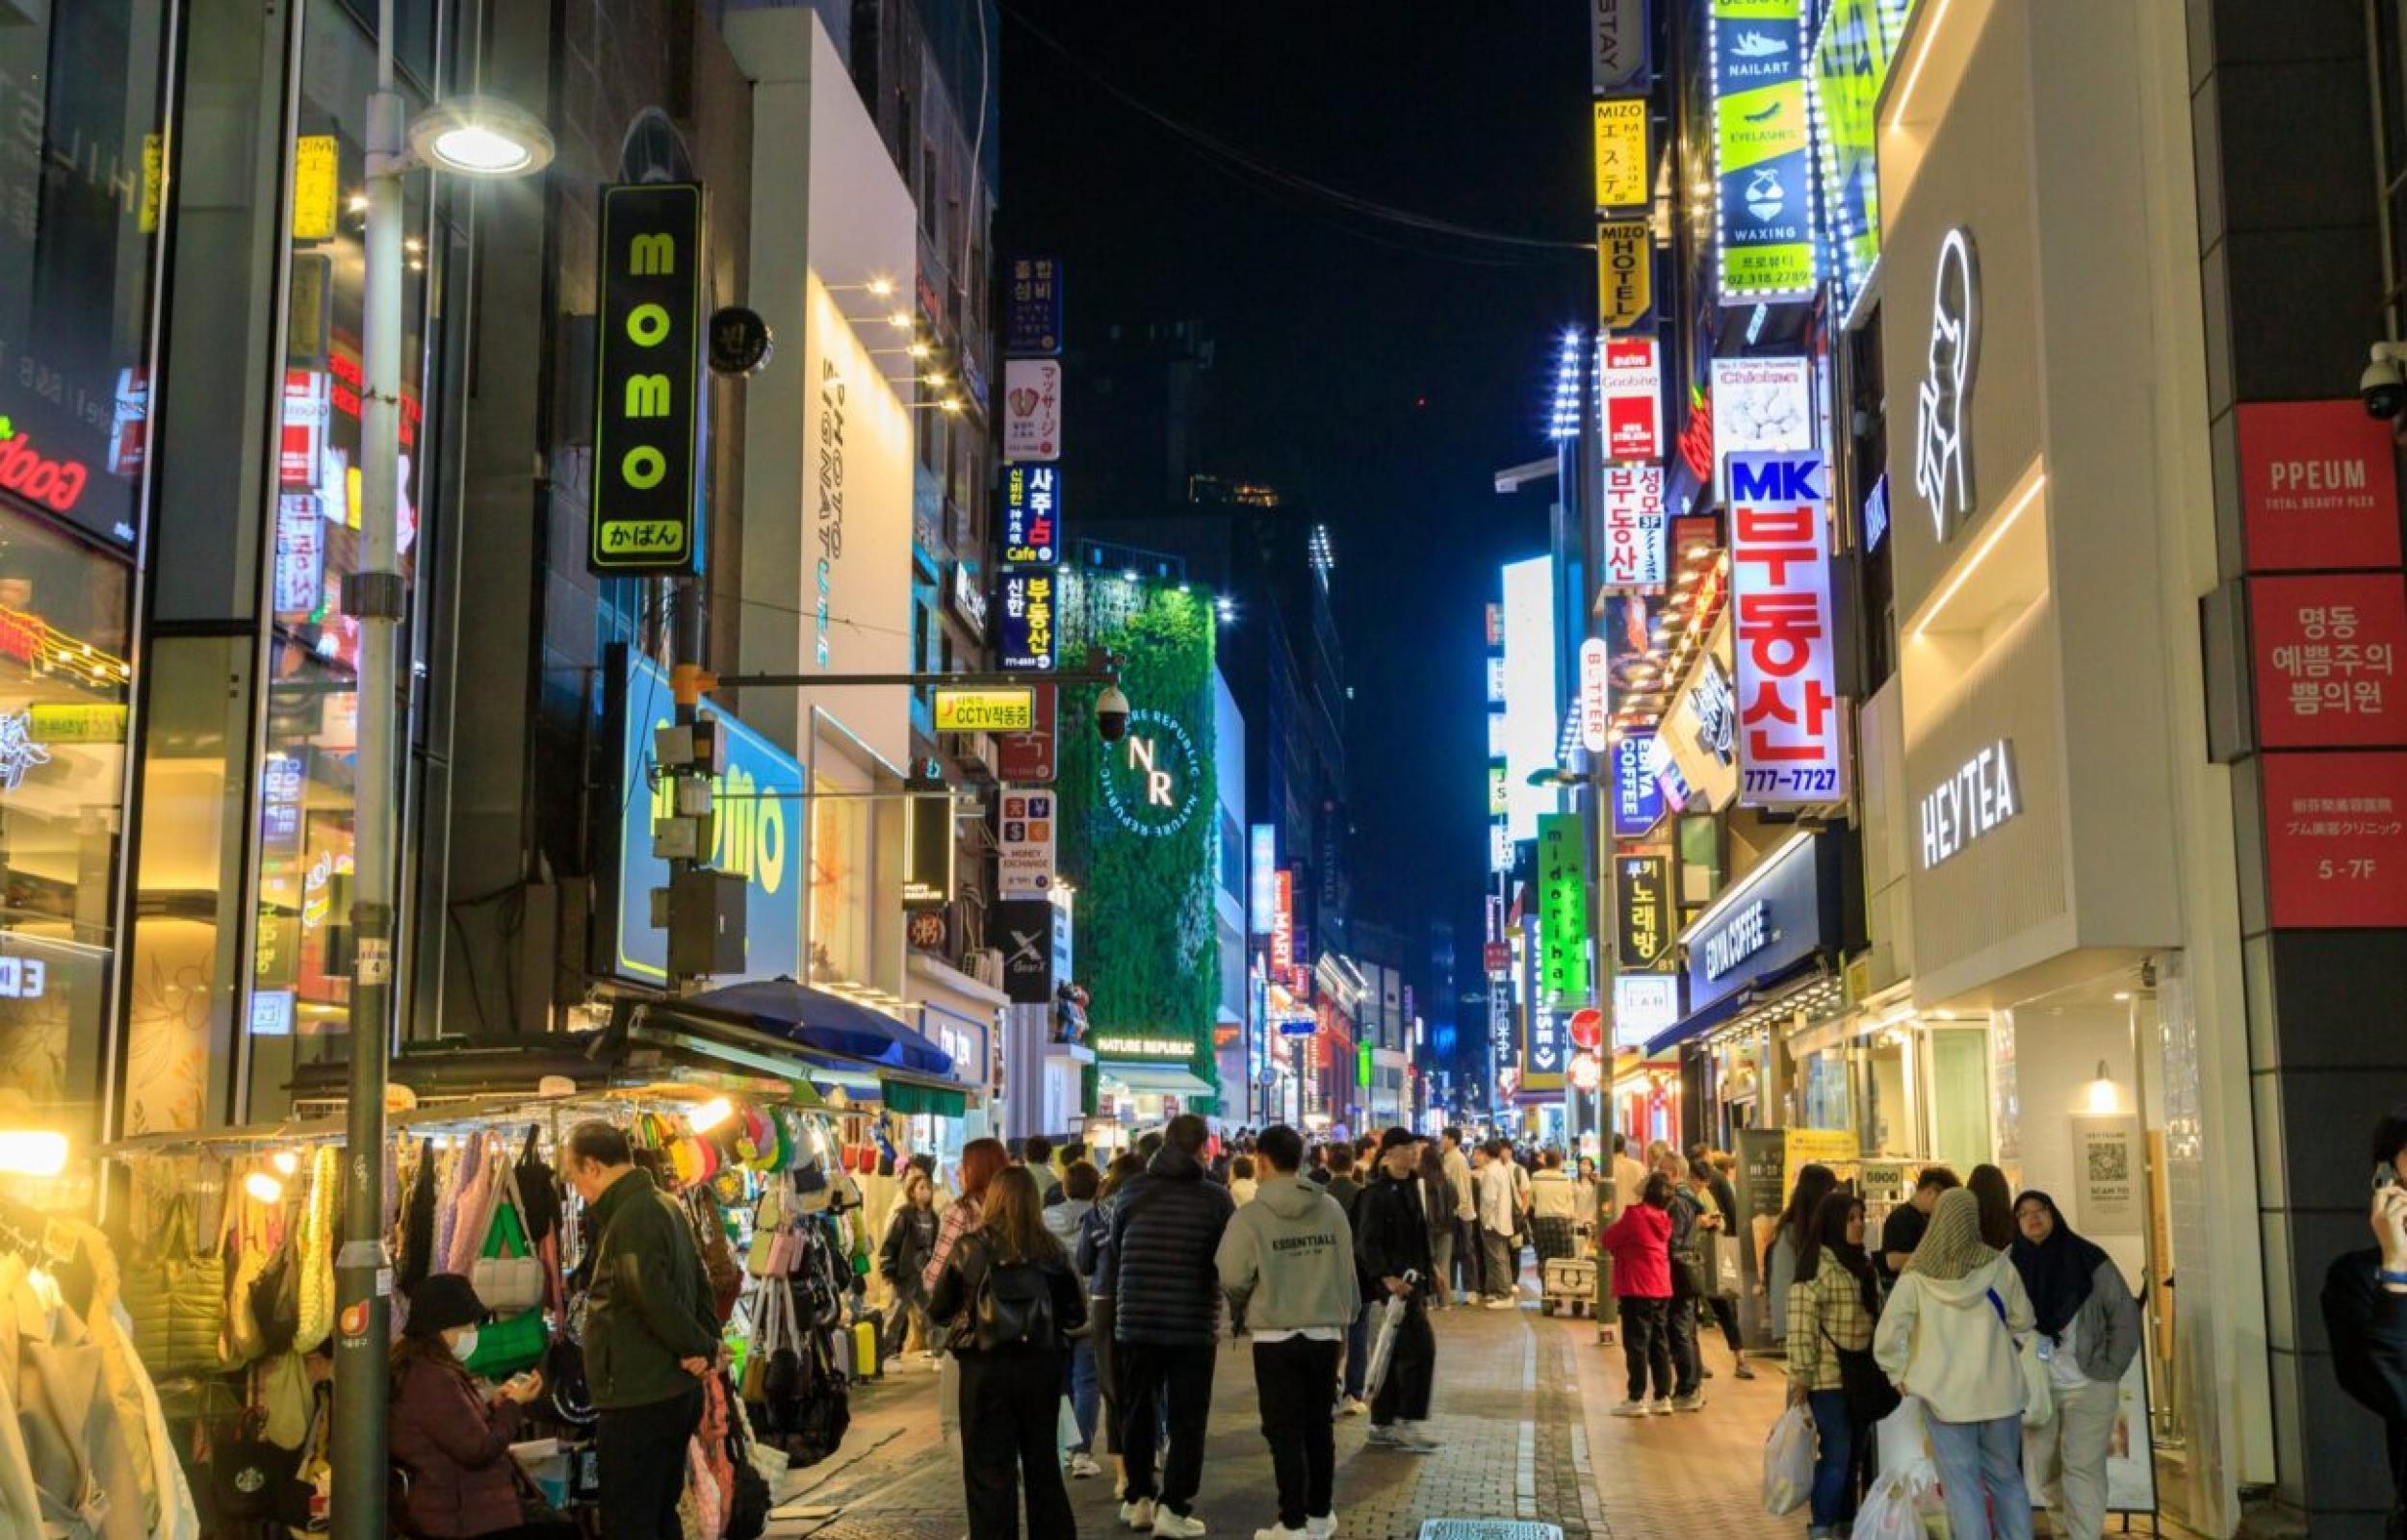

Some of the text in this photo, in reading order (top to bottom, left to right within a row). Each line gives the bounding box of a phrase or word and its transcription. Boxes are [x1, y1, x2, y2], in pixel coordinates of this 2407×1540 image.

[1729, 62, 1790, 77] NAILART
[1598, 105, 1642, 118] MIZO
[1601, 123, 1619, 193] エステ
[1602, 226, 1644, 240] MIZO
[1735, 226, 1796, 242] WAXING
[1613, 240, 1635, 315] HOTEL
[622, 232, 674, 489] momo
[1732, 460, 1823, 500] MK
[2270, 459, 2367, 491] PPEUM
[609, 524, 676, 546] かばん
[1608, 470, 1638, 581] 부동산
[1007, 547, 1037, 562] Cafe
[1026, 578, 1051, 655] 부동산
[1735, 506, 1833, 761] 부동산
[2299, 606, 2359, 640] 명동
[2272, 643, 2394, 678] 예쁨주의
[2289, 680, 2384, 716] 쁨의원
[1620, 738, 1638, 815] COFFEE
[1745, 769, 1836, 793] 777-7727
[1922, 737, 2013, 870] HEYTEA
[1631, 881, 1658, 958] 노래방
